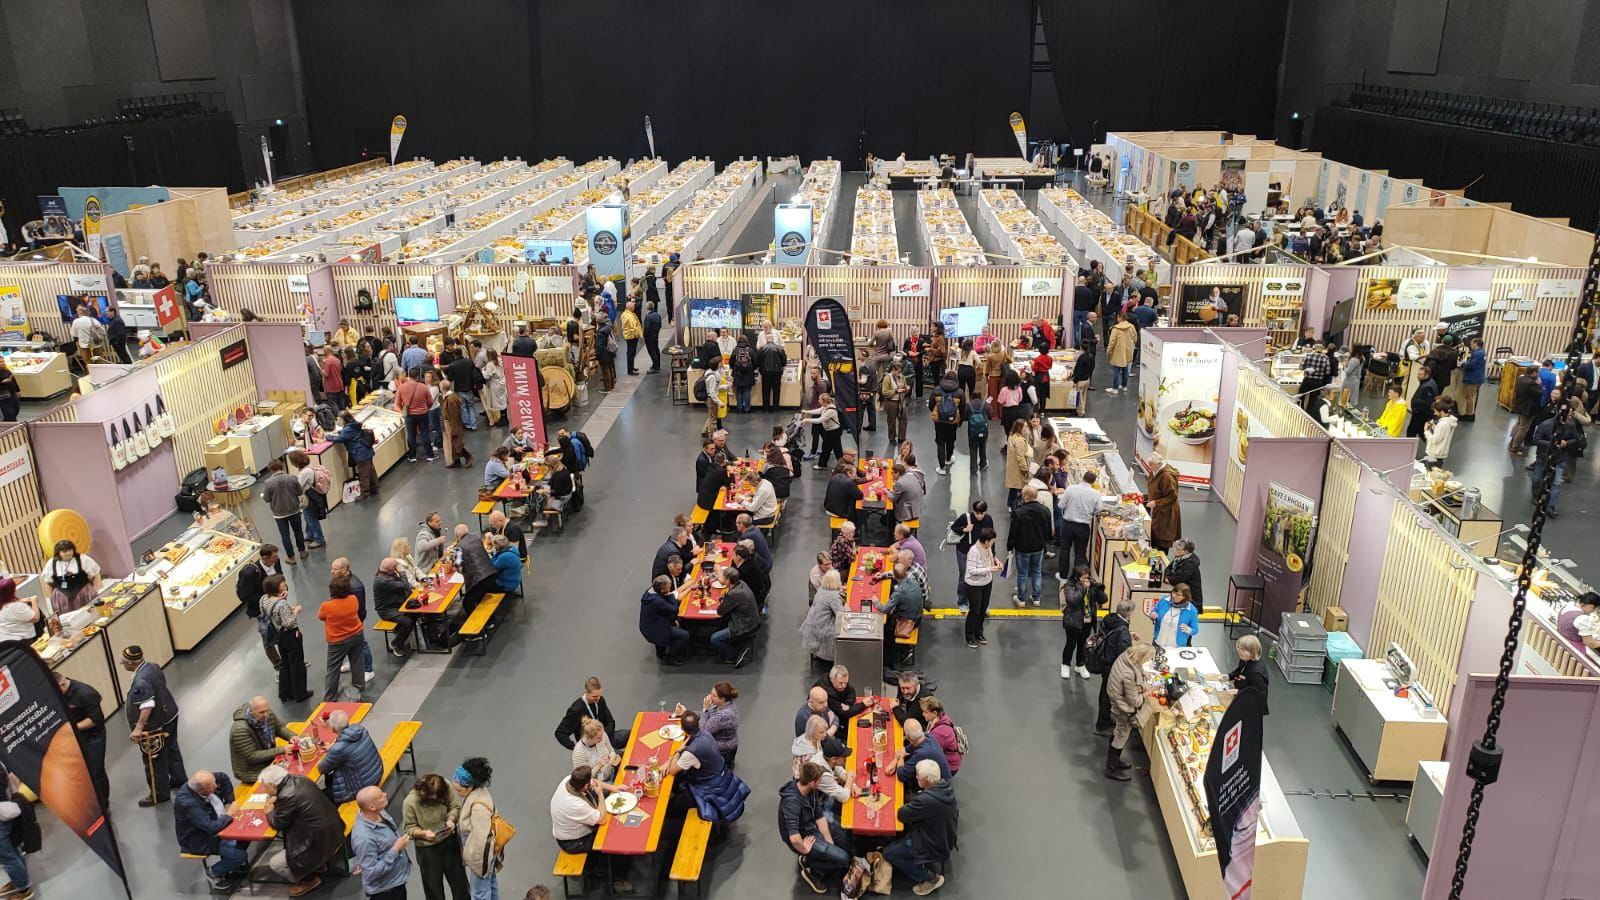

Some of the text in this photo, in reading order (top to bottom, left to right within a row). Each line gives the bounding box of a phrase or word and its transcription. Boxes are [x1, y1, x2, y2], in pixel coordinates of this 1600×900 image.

[1270, 488, 1284, 499] CAVE
[1287, 497, 1310, 513] RHODAN
[0, 701, 39, 735] L'essentiel
[3, 731, 16, 743] est
[16, 705, 48, 734] invisible
[6, 734, 26, 754] pour
[24, 726, 37, 737] les
